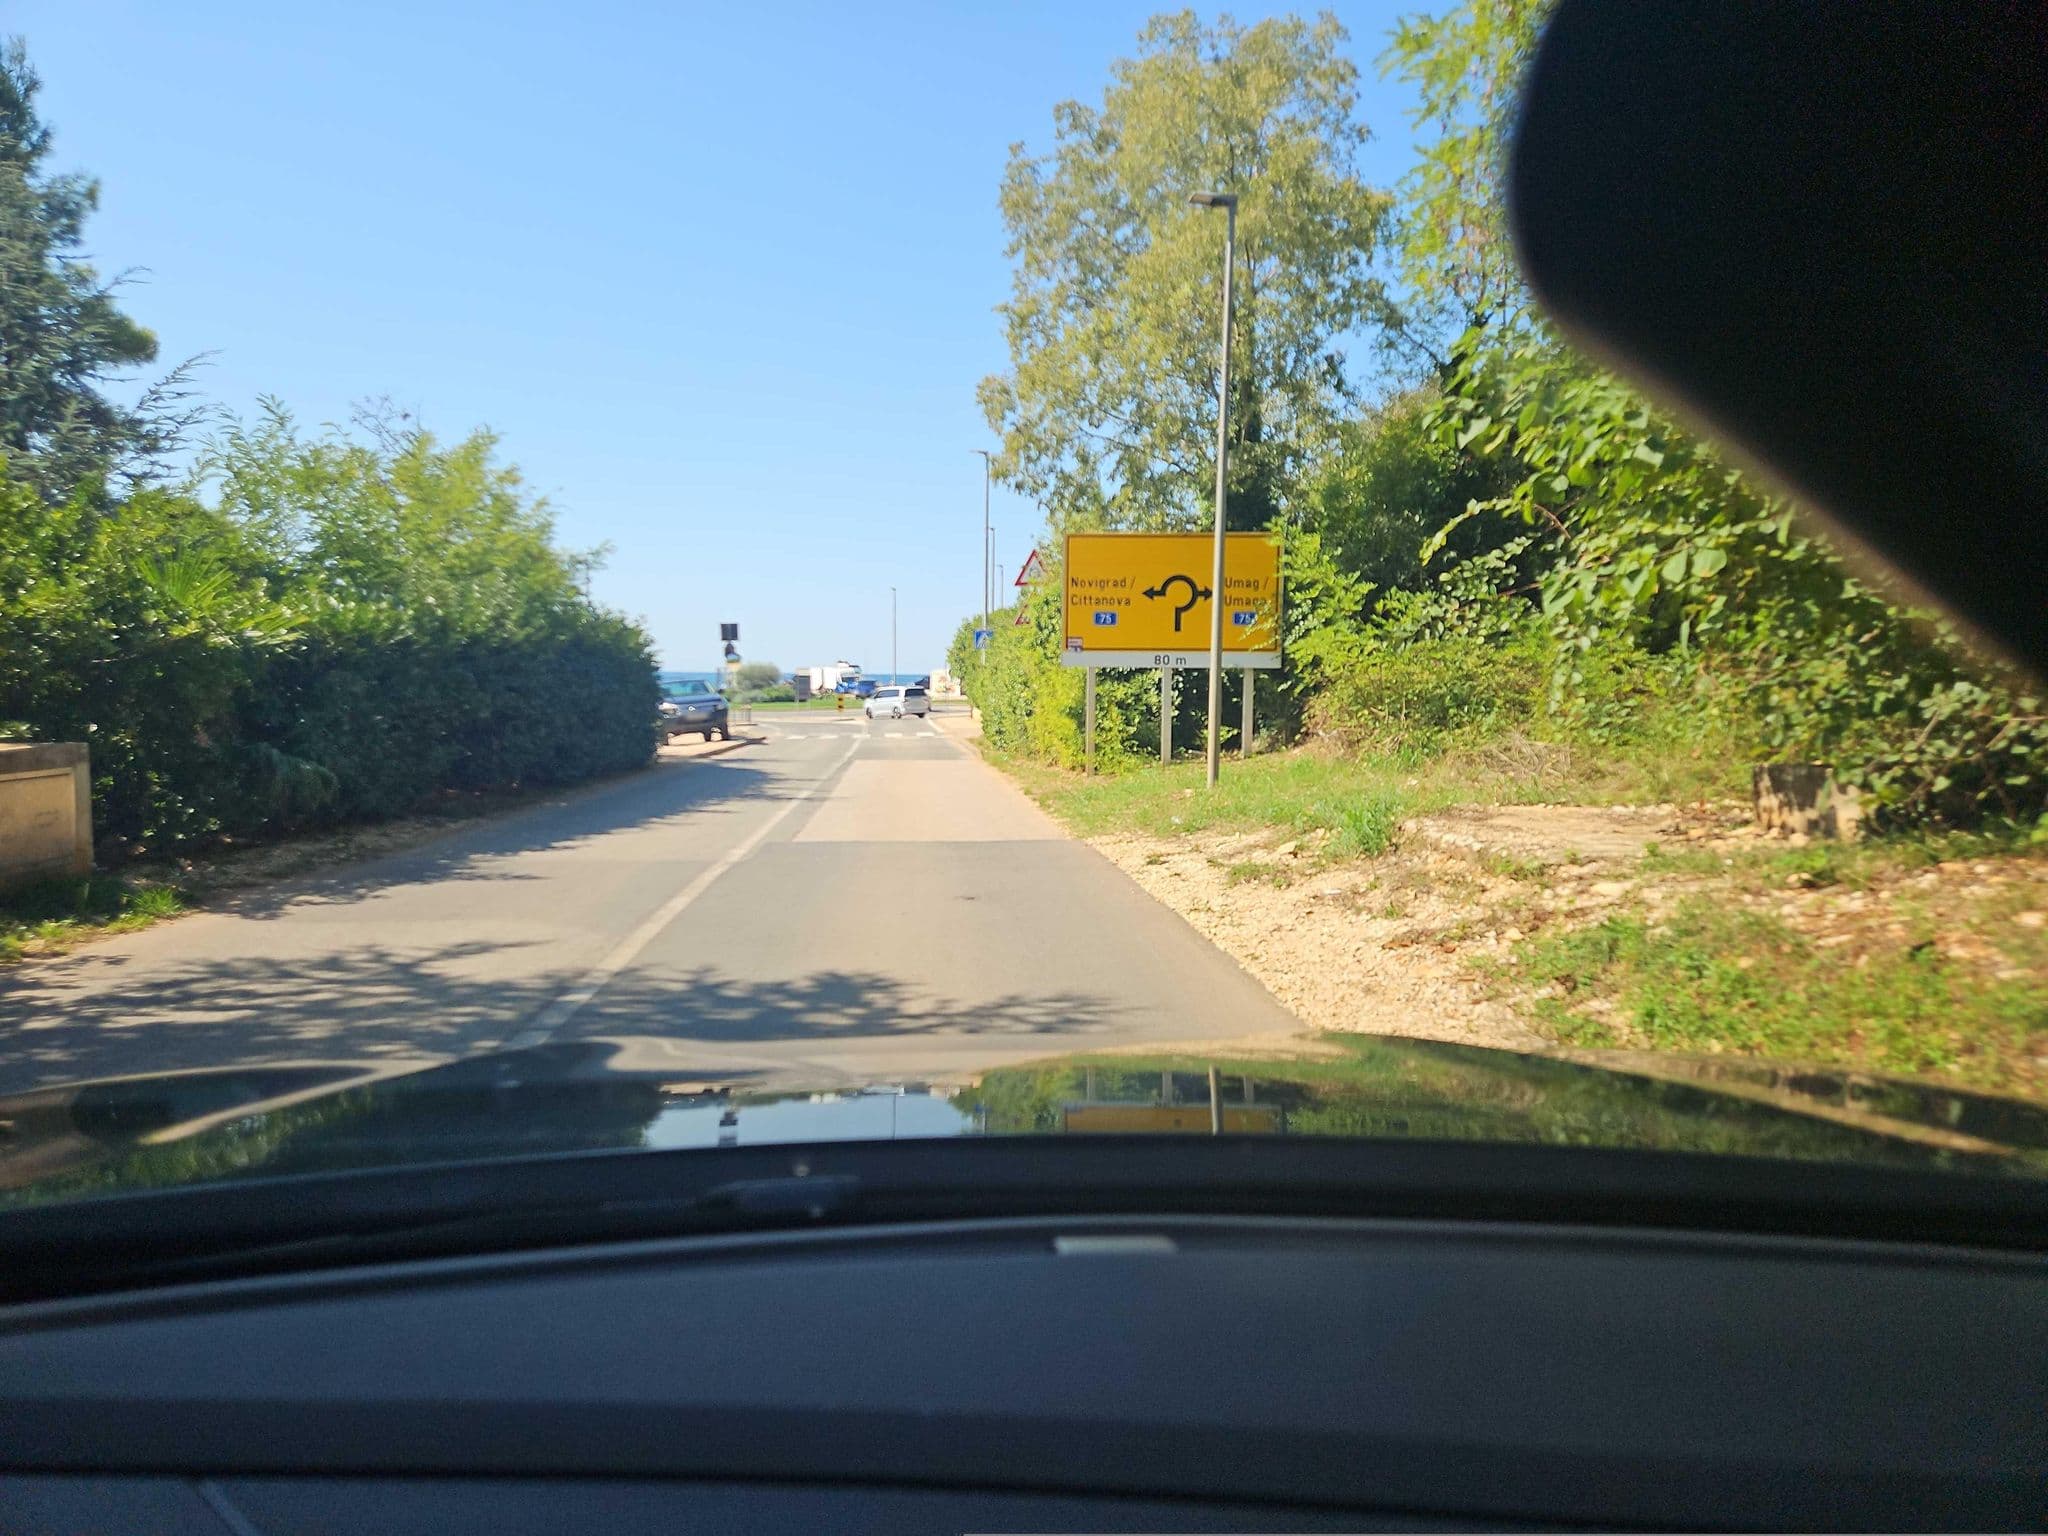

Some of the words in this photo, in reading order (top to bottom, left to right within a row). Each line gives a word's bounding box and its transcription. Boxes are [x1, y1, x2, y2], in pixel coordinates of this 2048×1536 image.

[1071, 577, 1127, 590] Novigrad
[1225, 577, 1260, 591] Umag
[1071, 594, 1131, 606] Cittanova
[1100, 614, 1112, 625] 75
[1240, 614, 1252, 625] 75
[1154, 655, 1170, 665] 80
[1175, 656, 1187, 665] m
